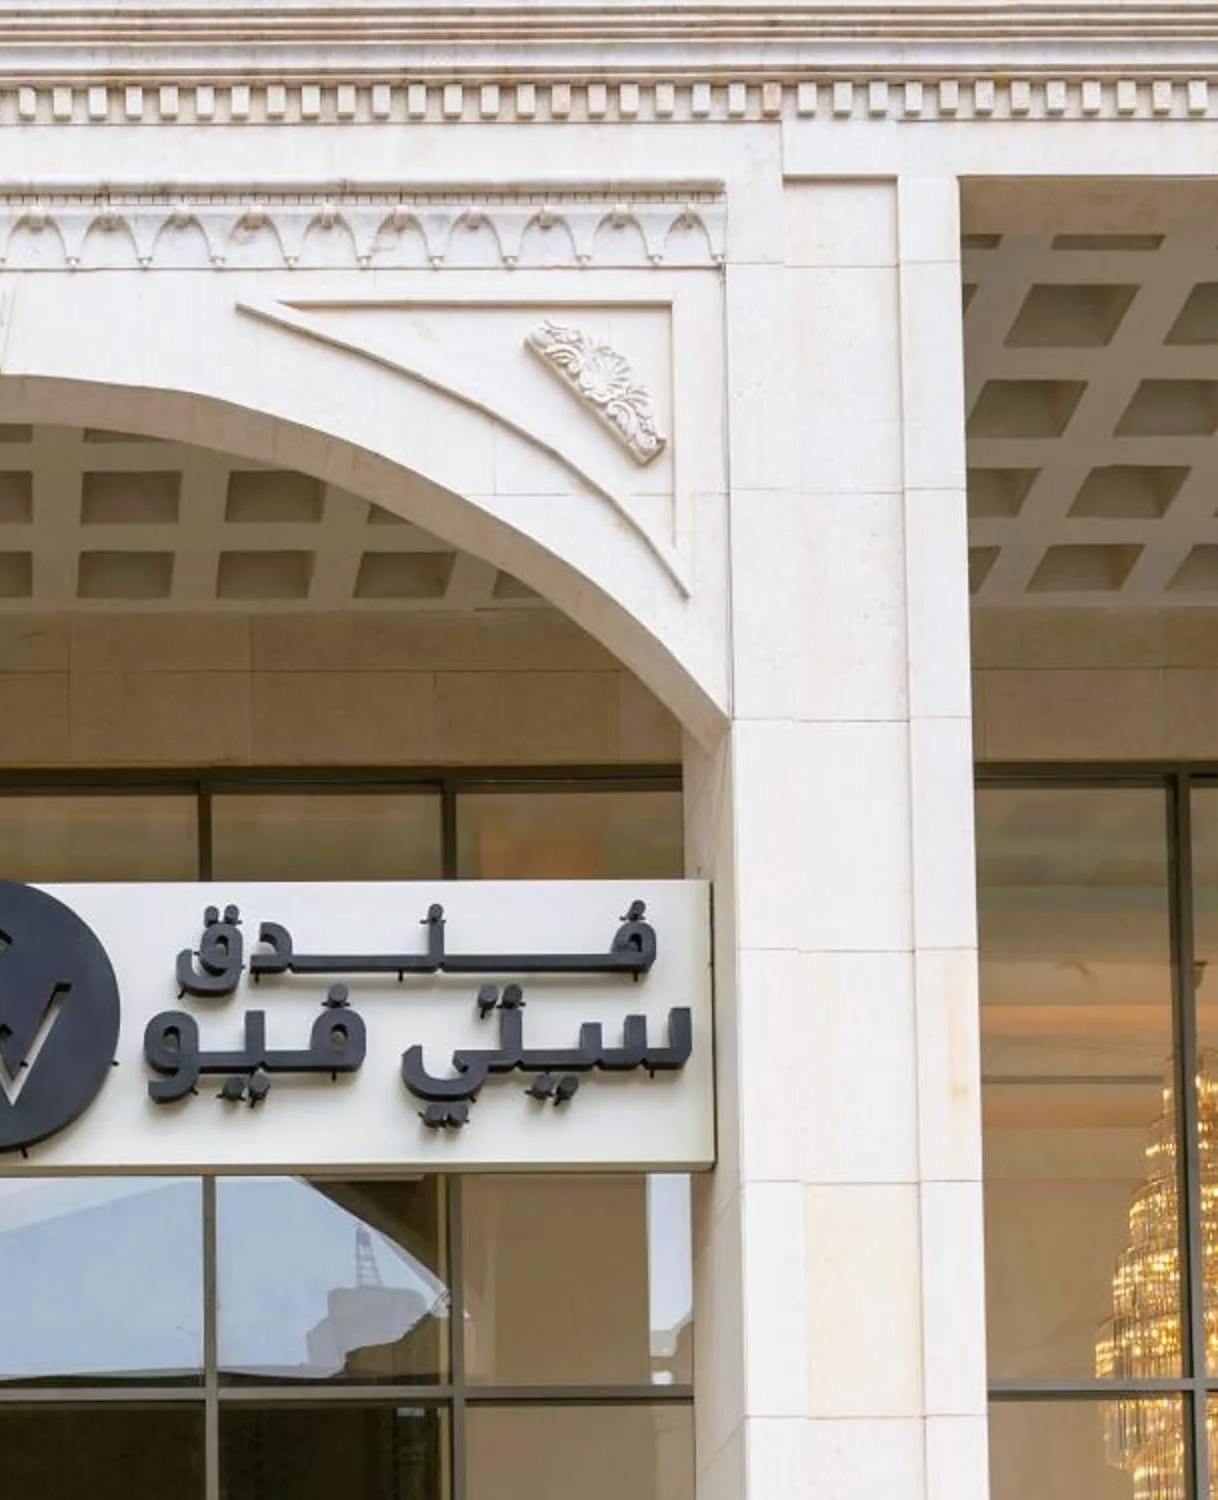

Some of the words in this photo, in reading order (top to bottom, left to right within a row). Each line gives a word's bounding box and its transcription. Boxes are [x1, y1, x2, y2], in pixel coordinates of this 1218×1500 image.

[176, 900, 657, 998] فندق
[143, 984, 368, 1110] فيو
[402, 984, 693, 1130] سيتي
